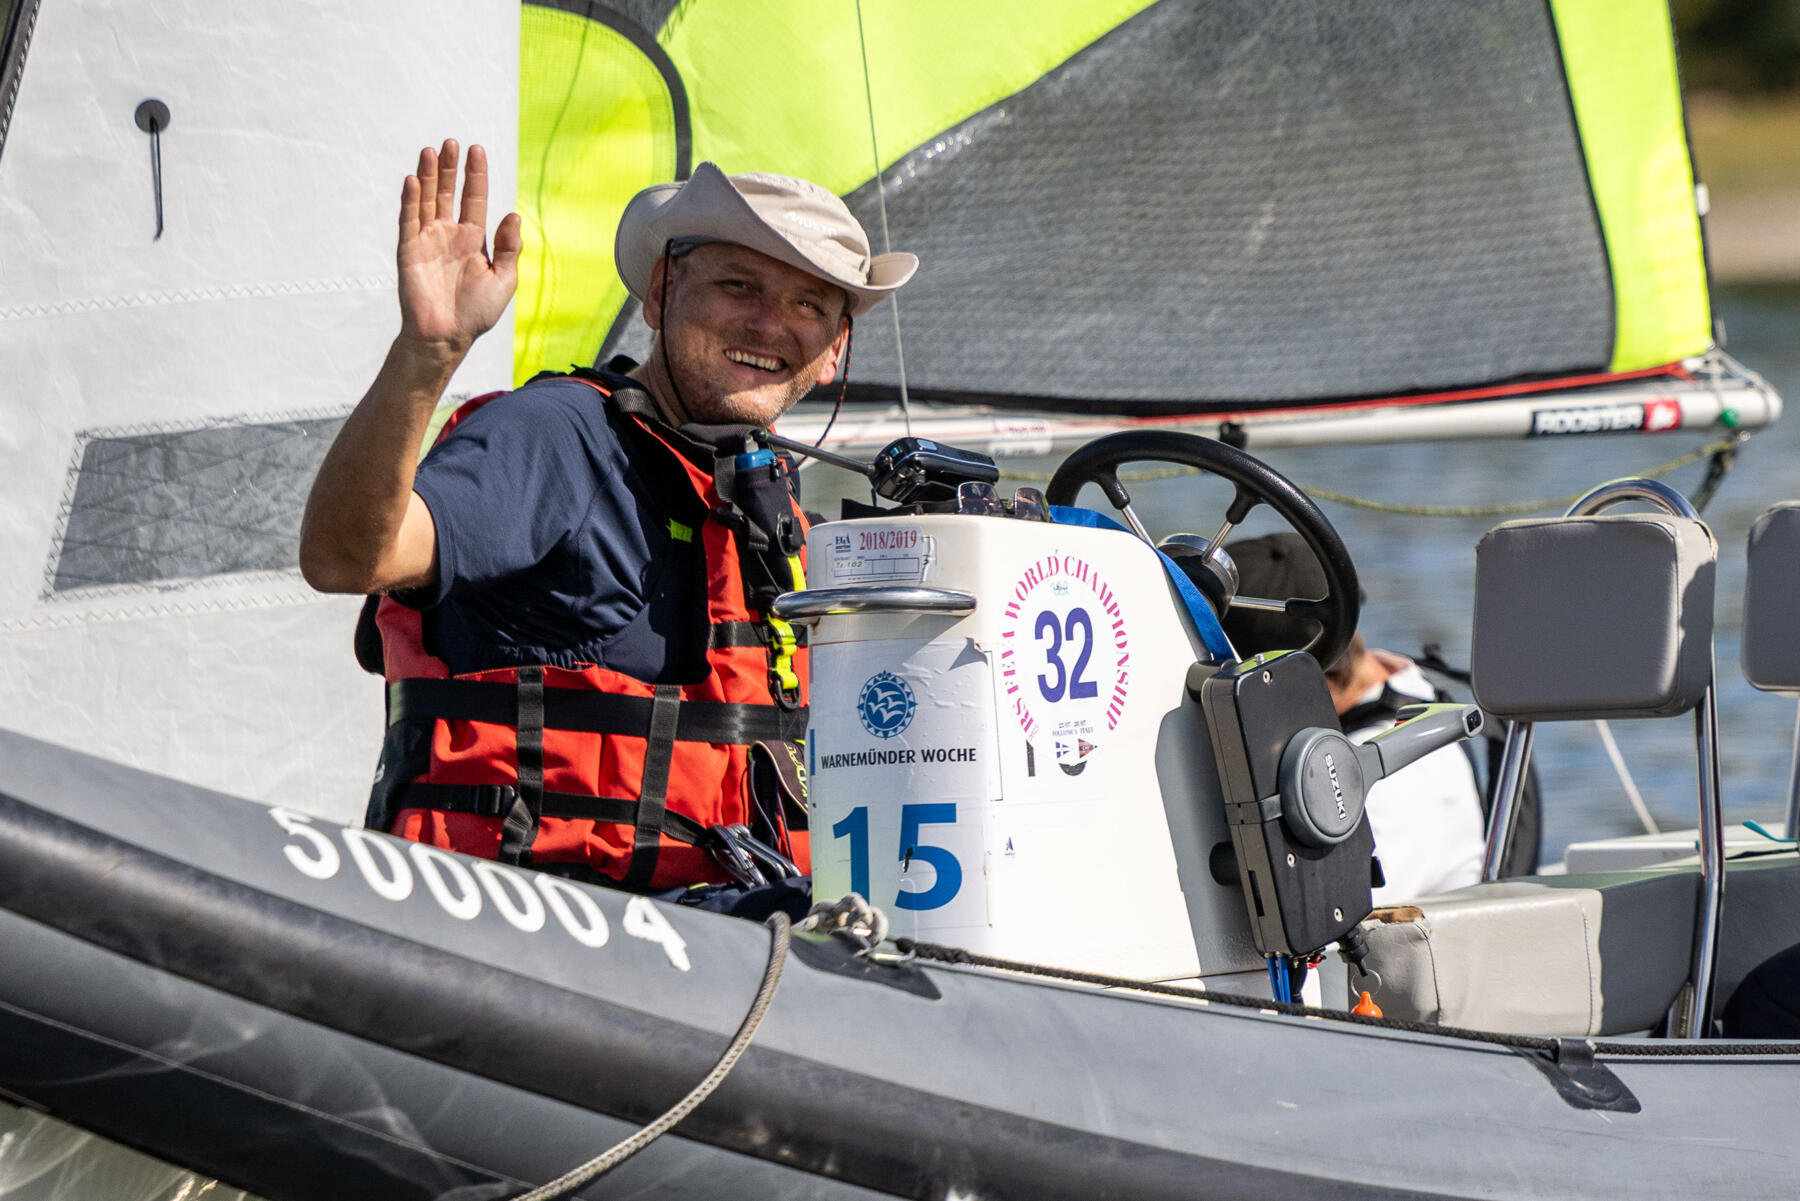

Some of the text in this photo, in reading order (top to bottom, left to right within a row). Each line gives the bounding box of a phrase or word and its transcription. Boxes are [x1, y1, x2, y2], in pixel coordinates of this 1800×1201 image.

[1535, 406, 1643, 433] ROOSTER
[860, 530, 917, 551] 2018/2019
[1004, 555, 1060, 619] WORLD
[1001, 631, 1020, 695] FEVA
[1034, 607, 1099, 704] 32
[1064, 555, 1130, 731] CHAMPIONSHIP
[821, 748, 977, 770] WARNEMÜNDER WOCHE
[1325, 753, 1346, 819] SUZUKI
[832, 803, 963, 912] 15
